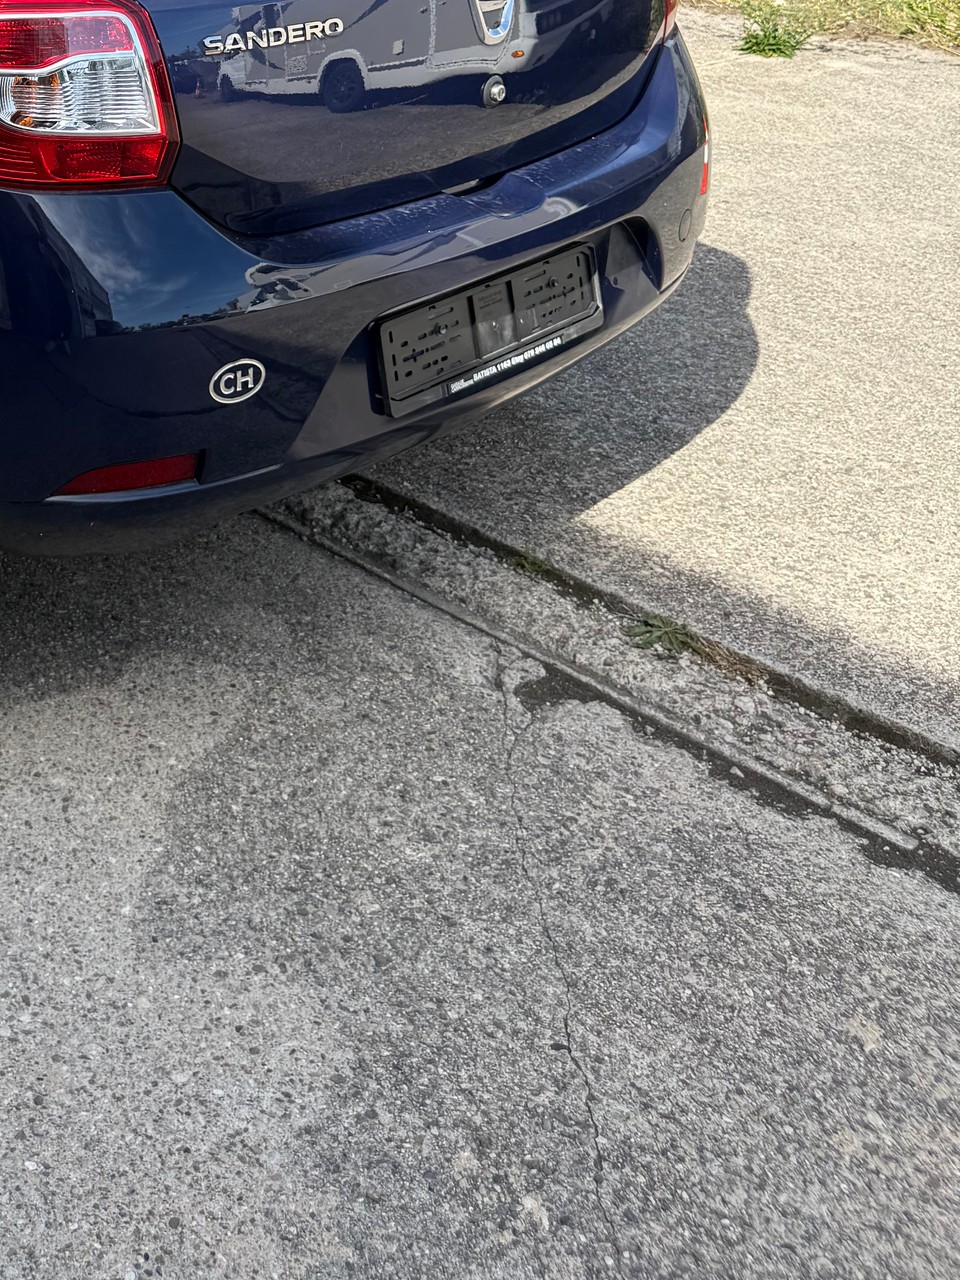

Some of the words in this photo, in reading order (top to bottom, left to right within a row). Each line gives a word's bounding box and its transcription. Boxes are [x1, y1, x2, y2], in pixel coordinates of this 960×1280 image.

[203, 18, 344, 55] SANDERO
[220, 367, 254, 395] CH
[473, 366, 498, 382] BATISTA
